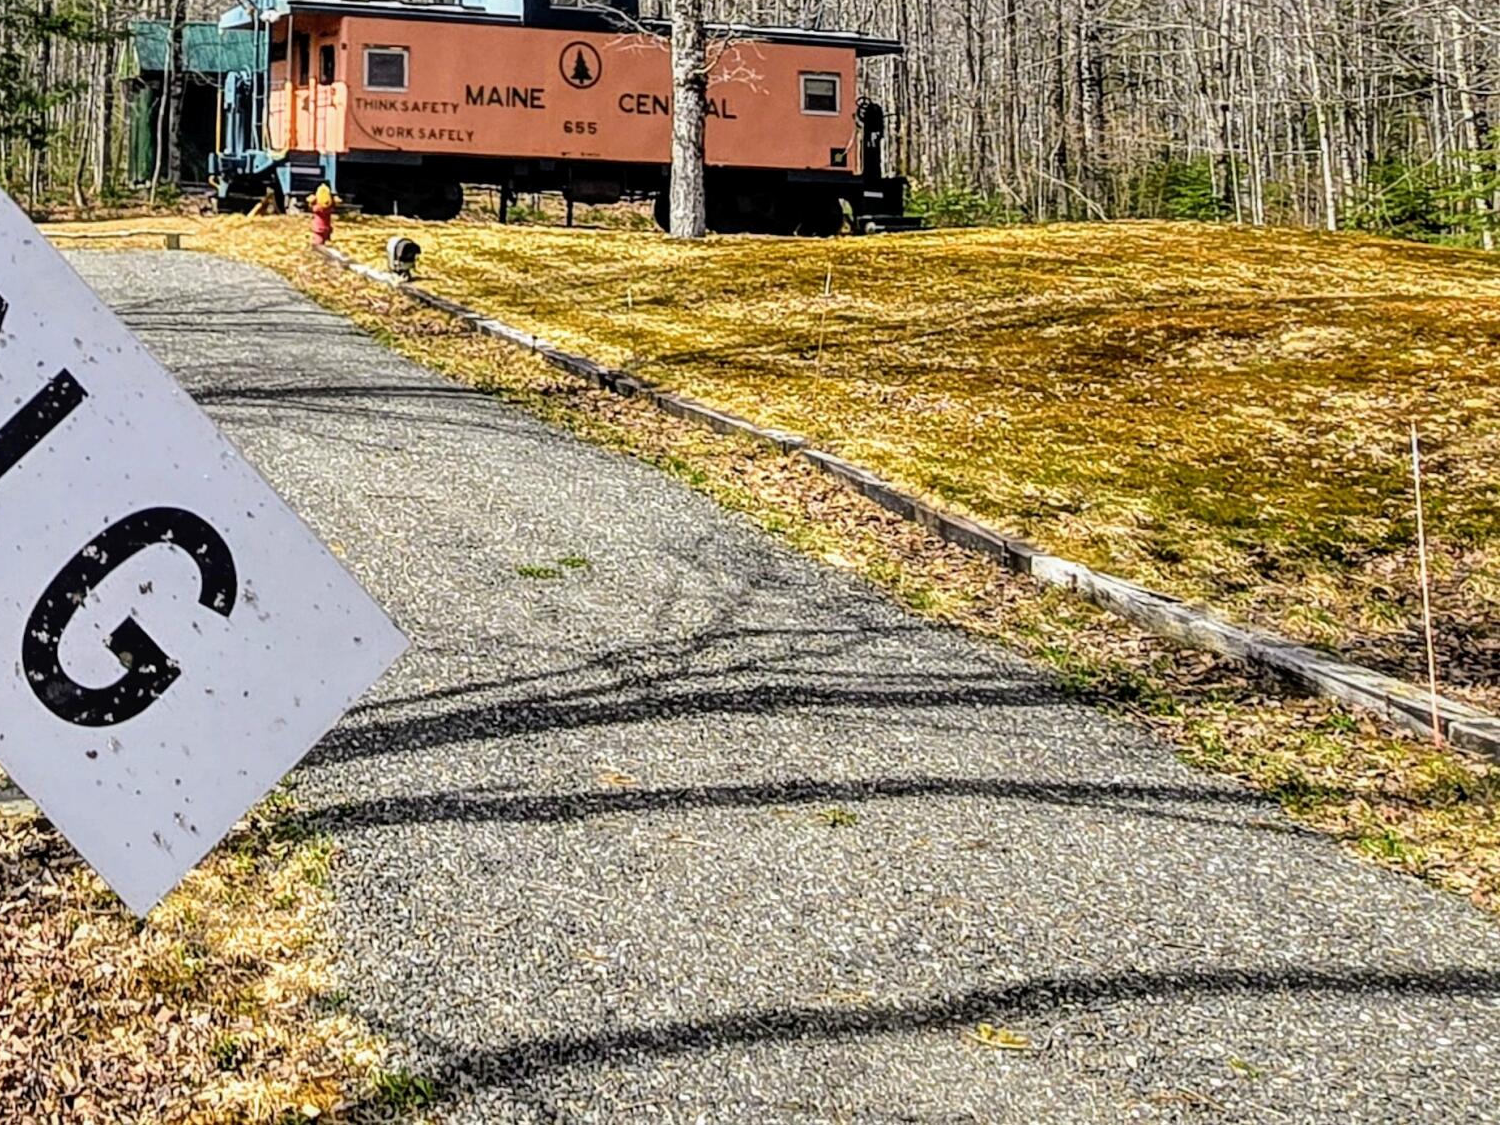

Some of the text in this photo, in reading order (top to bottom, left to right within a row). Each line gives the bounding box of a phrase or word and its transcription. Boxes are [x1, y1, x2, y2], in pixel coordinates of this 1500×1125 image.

[355, 97, 460, 115] THINK SAFETY
[465, 84, 737, 119] MAINE CENAL
[371, 125, 475, 142] WORK SAFELY
[563, 120, 598, 135] 655
